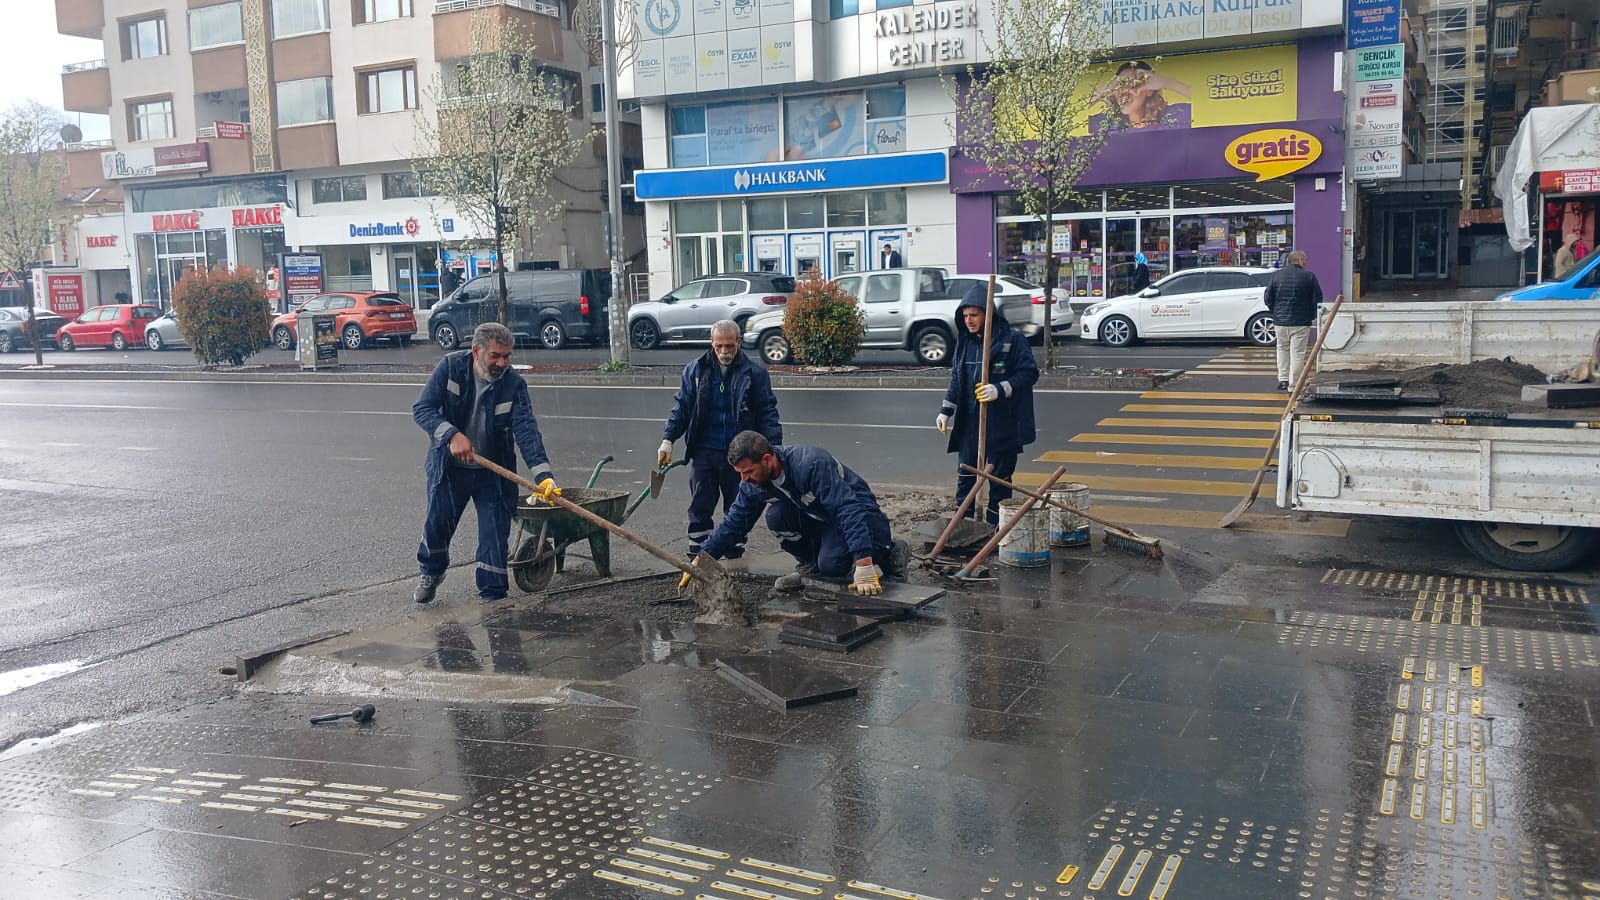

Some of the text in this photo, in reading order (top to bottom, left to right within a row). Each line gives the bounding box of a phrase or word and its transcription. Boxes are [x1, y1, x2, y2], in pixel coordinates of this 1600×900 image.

[874, 4, 977, 37] KALENDER
[1135, 11, 1293, 41] YABANCI DİL KURSU
[731, 51, 757, 61] EXAM
[889, 37, 964, 66] CENTER
[1363, 48, 1396, 61] GENÇLİK
[1358, 61, 1401, 71] SÜRÜCÜ KURSU
[1207, 69, 1283, 87] Size Güzel
[1209, 84, 1285, 99] Bakıyoruz
[1369, 121, 1400, 130] Novara
[1236, 134, 1310, 165] gratis
[751, 168, 826, 186] HALKBANK
[350, 222, 403, 238] DenizBank
